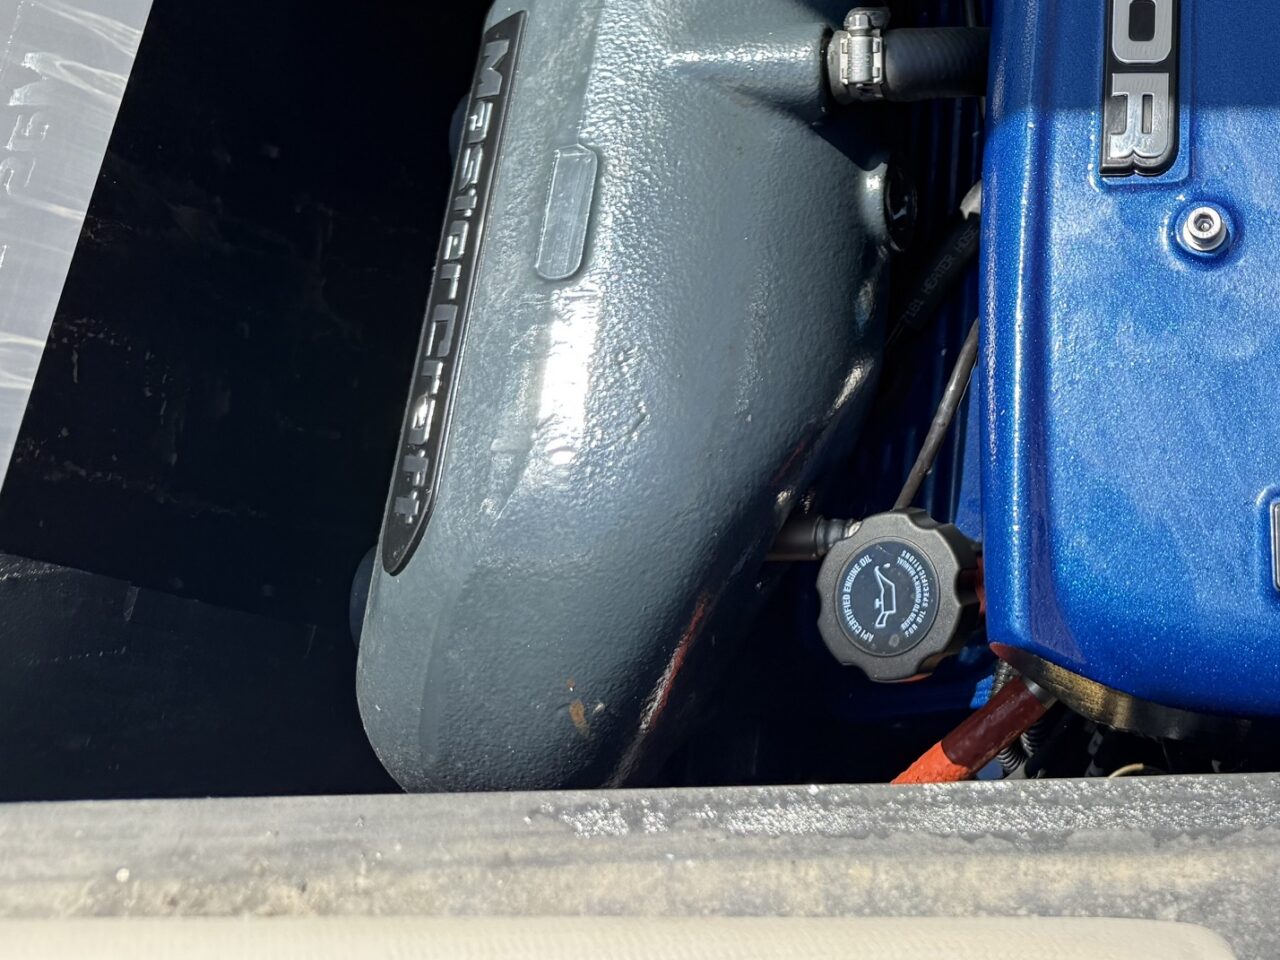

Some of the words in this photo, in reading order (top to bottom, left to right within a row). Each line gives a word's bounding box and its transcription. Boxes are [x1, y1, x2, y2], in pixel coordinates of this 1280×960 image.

[394, 38, 511, 525] MasterCraft
[859, 554, 873, 567] OIL
[896, 556, 916, 577] MANUAL
[842, 563, 861, 592] ENGINE
[900, 549, 930, 608] SPECIFICATIONS
[842, 594, 863, 633] CERTIFIED
[913, 604, 921, 613] TO
[916, 610, 927, 624] OIL
[900, 613, 917, 631] REFER
[904, 623, 918, 638] FOR
[860, 629, 875, 643] API
